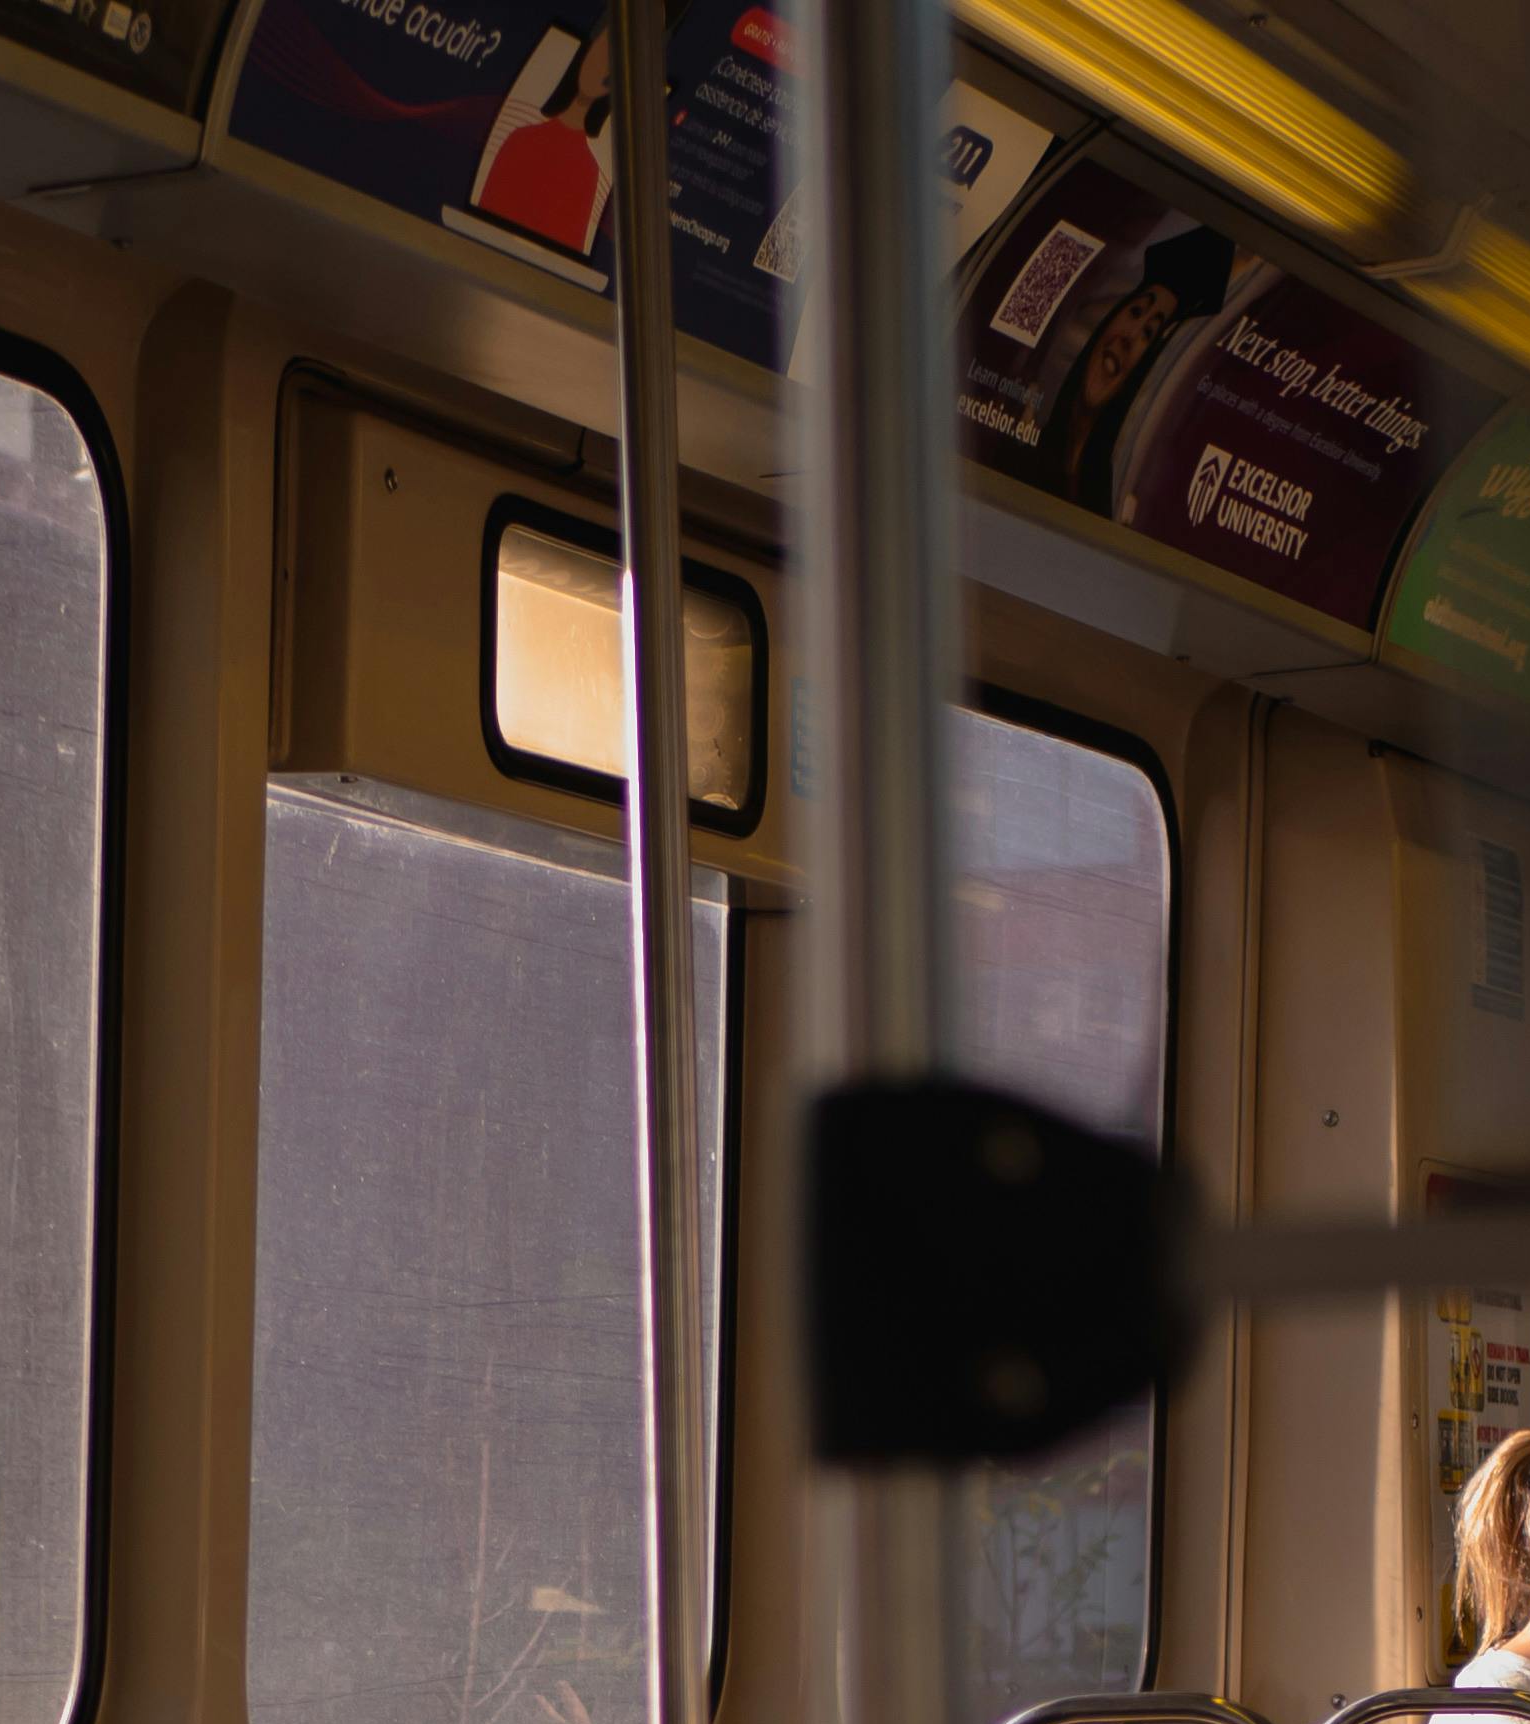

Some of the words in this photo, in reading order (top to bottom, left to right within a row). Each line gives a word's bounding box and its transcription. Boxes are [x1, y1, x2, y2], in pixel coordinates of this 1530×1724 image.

[404, 3, 502, 69] acudir?
[947, 135, 984, 175] 211
[967, 357, 1000, 385] Learn
[1216, 314, 1278, 367] Next
[1264, 349, 1318, 398] stop,
[1309, 363, 1378, 419] better
[956, 393, 1042, 447] excelsior.edu
[1228, 458, 1314, 521] EXCELSIOR
[1217, 495, 1309, 560] UNIVERSITY
